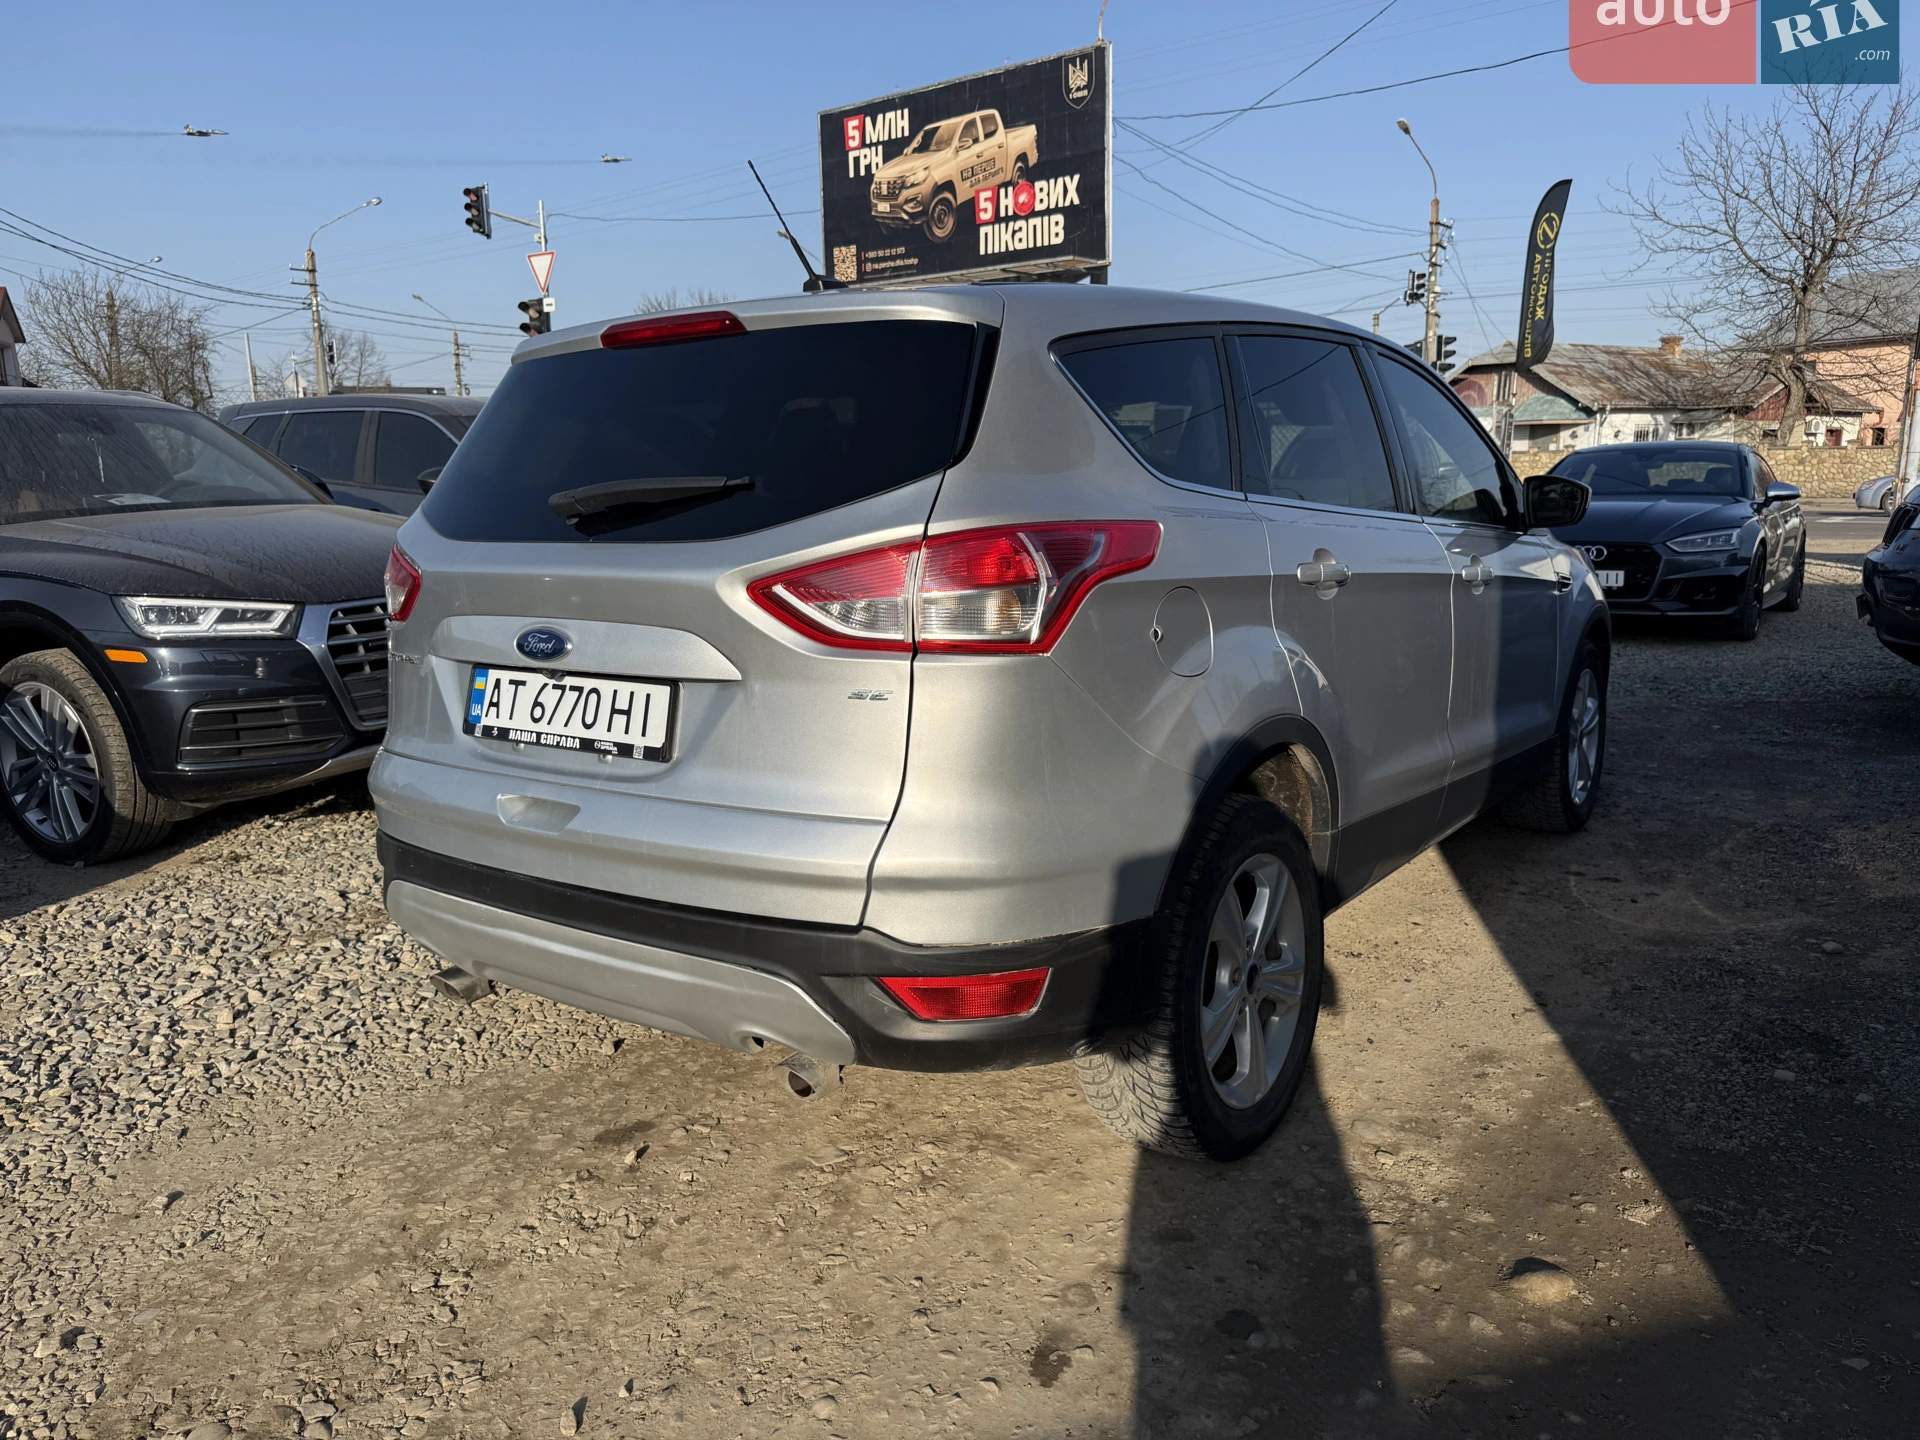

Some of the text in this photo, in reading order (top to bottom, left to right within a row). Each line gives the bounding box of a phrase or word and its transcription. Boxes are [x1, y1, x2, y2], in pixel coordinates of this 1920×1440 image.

[847, 107, 910, 148] 5 МЛН
[848, 144, 883, 179] ГРН
[979, 189, 993, 221] 5
[523, 632, 556, 654] Ford
[471, 703, 482, 716] UA
[484, 677, 651, 738] AT 6770 HI
[508, 729, 581, 750] НАША СПРАВА
